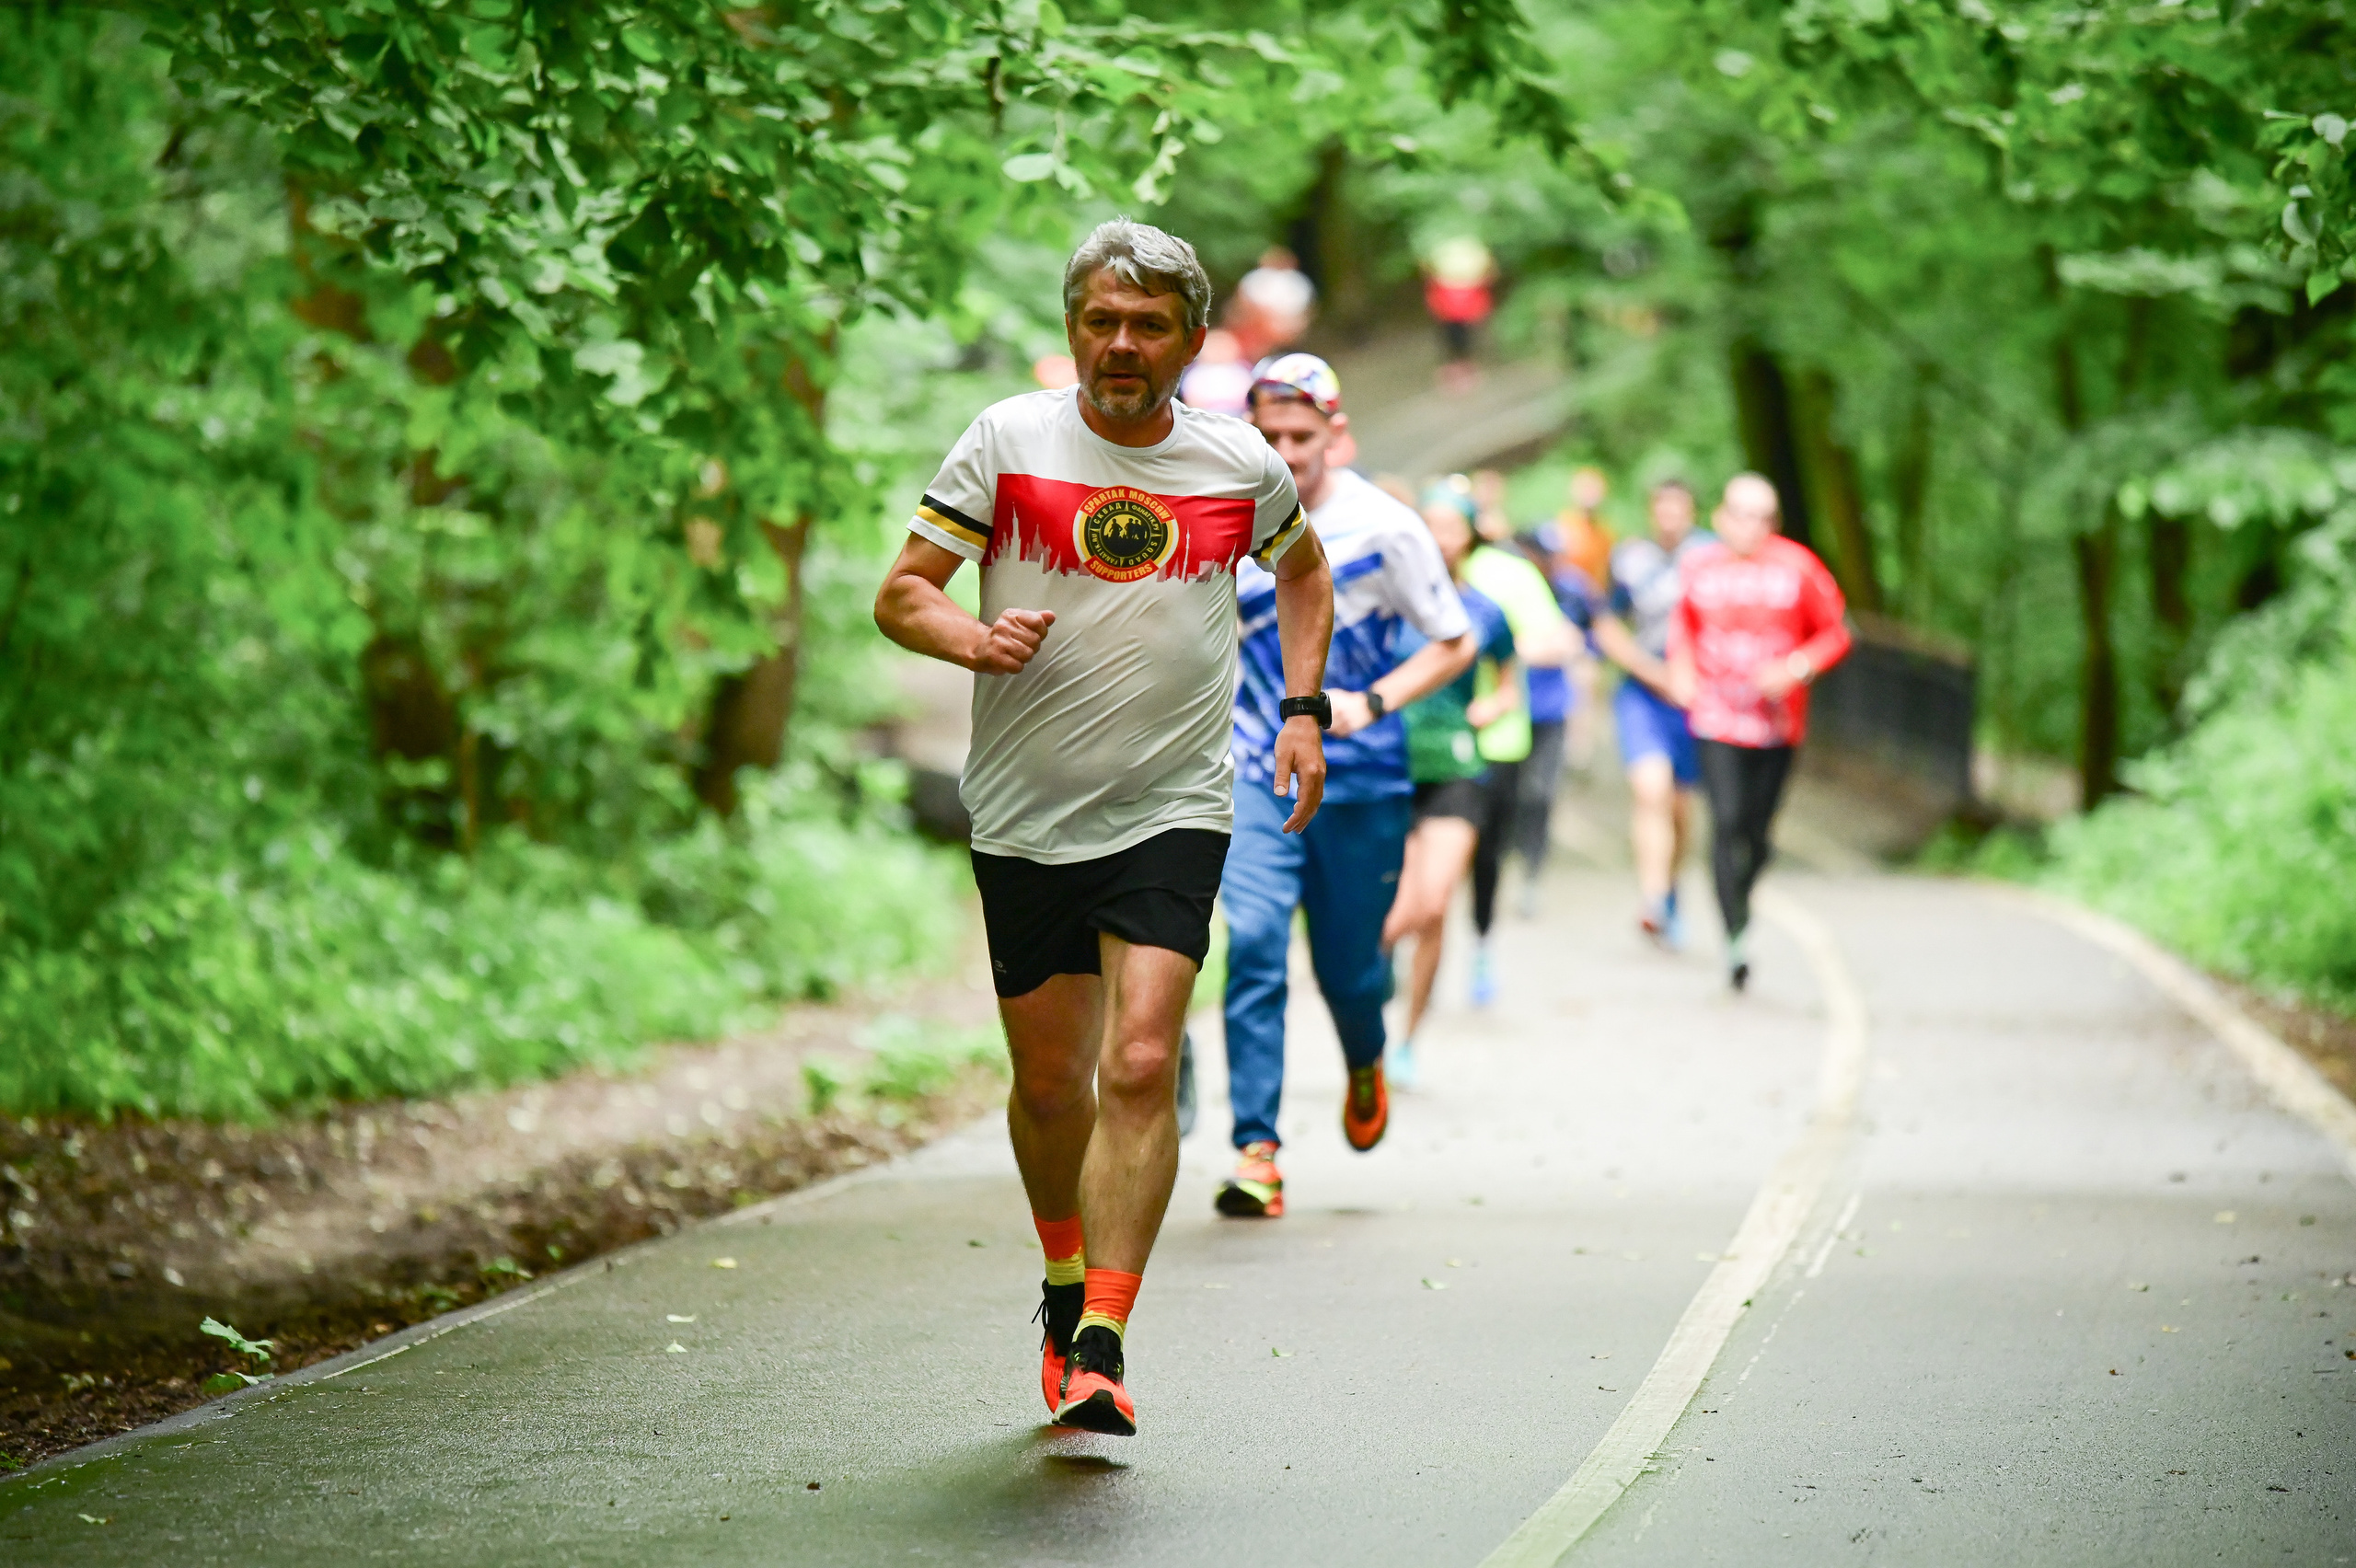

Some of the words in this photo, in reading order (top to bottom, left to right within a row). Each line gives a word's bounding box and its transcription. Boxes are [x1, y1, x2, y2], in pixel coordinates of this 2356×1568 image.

[1084, 489, 1125, 513] SPARTAK
[1128, 490, 1171, 520] MOSCOW
[1094, 502, 1122, 525] СКВАД
[1128, 541, 1158, 566] SQUAD
[1090, 559, 1153, 581] SUPPORTERS
